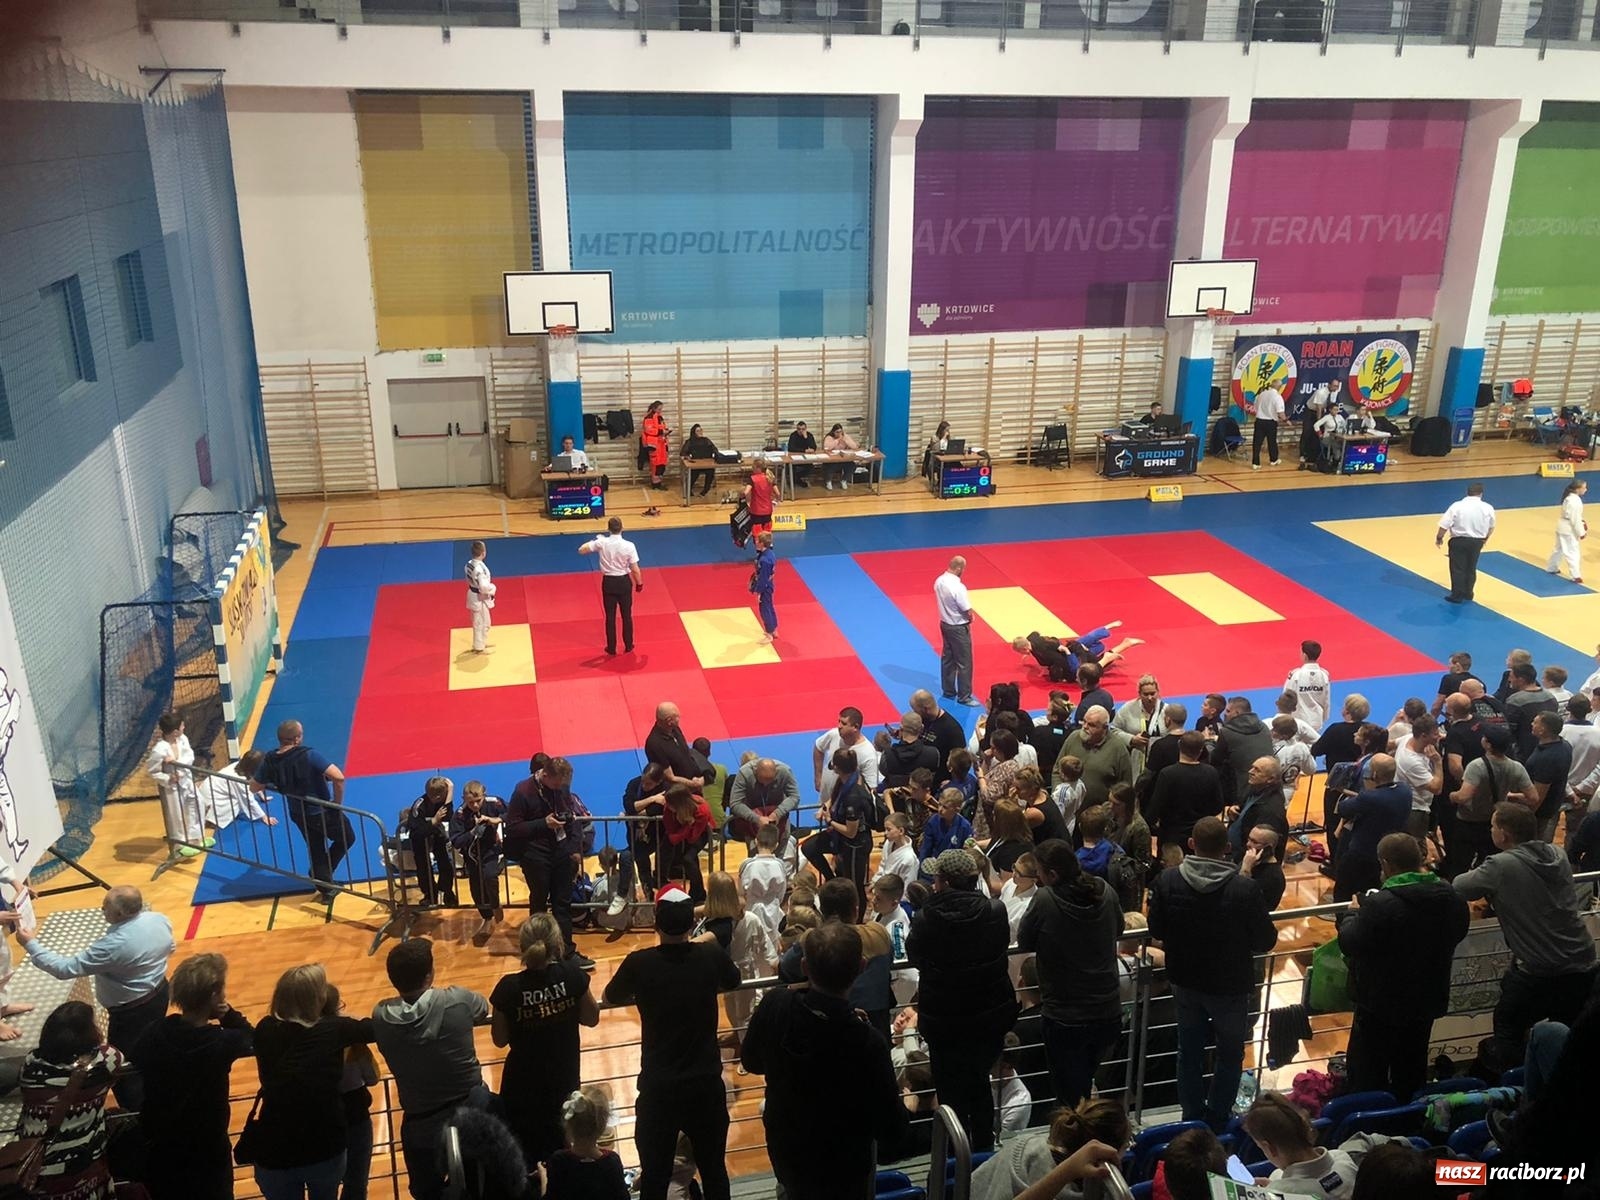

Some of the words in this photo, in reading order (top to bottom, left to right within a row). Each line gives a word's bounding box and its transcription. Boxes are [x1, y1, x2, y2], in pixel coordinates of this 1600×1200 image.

[915, 206, 1172, 255] AKTYWNOŚĆ
[1228, 211, 1445, 248] LTERNATYWA
[577, 222, 866, 256] METROPOLITALNOŚĆ
[1252, 296, 1281, 306] OWICE
[942, 303, 995, 315] KATOWICE
[620, 311, 676, 321] KATOWICE
[1300, 340, 1354, 358] ROAN
[1259, 344, 1282, 352] FIGHT
[1282, 350, 1295, 369] CLUB
[1300, 359, 1326, 369] FIGHT
[1327, 358, 1350, 368] CLUB
[1137, 449, 1185, 460] GROUND
[1376, 453, 1385, 463] 0
[1143, 458, 1177, 468] GAME
[980, 467, 990, 476] 0
[979, 476, 989, 486] 6
[590, 485, 602, 496] 0
[1173, 486, 1180, 497] 3
[591, 496, 602, 506] 2
[774, 515, 794, 524] MATA
[795, 514, 803, 527] 4
[522, 981, 567, 1006] ROAN
